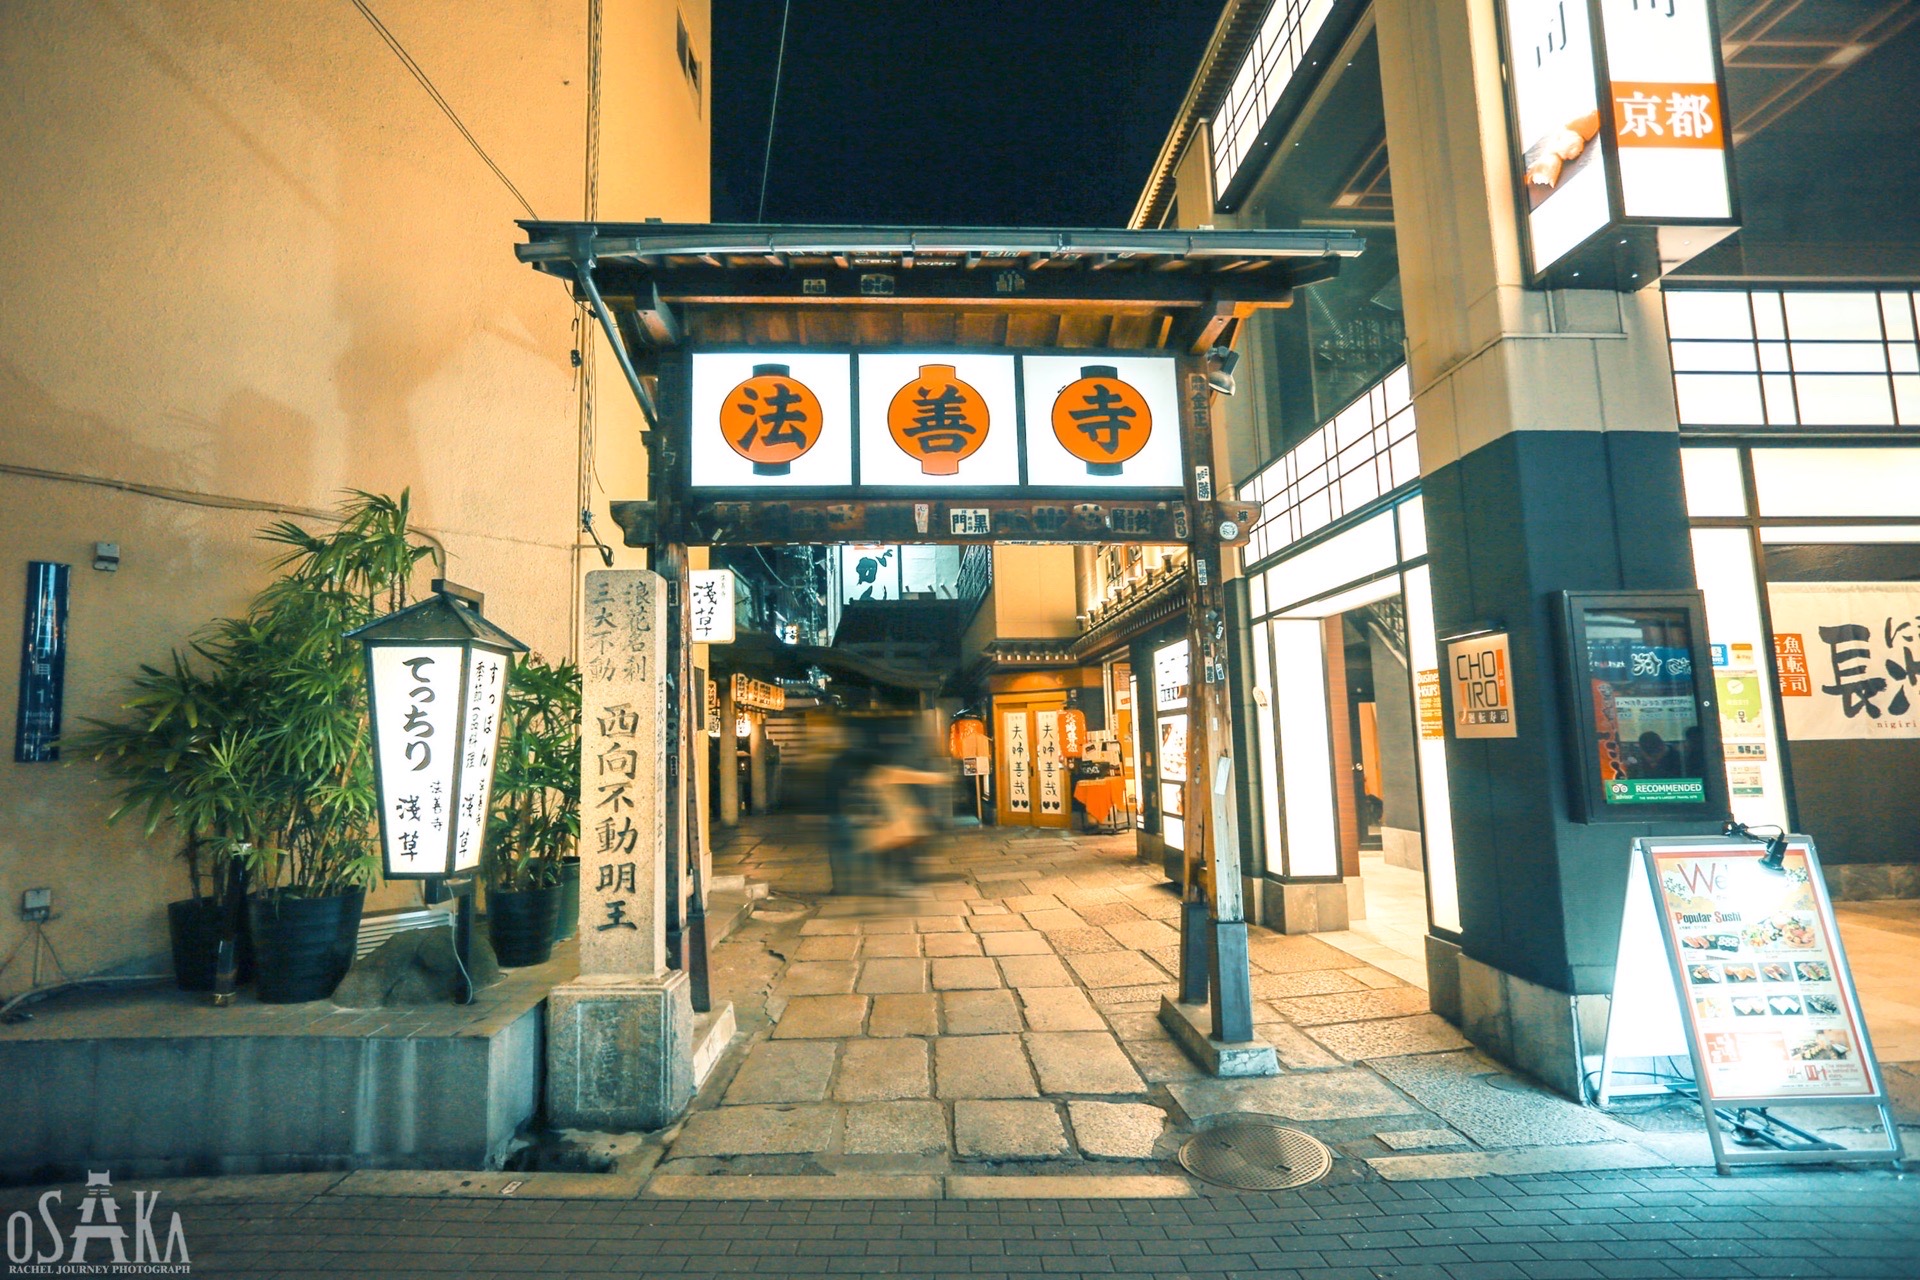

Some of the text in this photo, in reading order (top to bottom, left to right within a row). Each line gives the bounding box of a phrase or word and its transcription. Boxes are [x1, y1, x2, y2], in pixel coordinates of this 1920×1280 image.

[1615, 91, 1713, 139] 京都
[737, 383, 1135, 454] 法善寺
[1456, 650, 1496, 681] CHO
[402, 656, 436, 772] てっちり
[1635, 783, 1702, 793] RECOMMENDED
[595, 702, 639, 932] 西向不動明王
[1675, 910, 1742, 925] Popular Sushi
